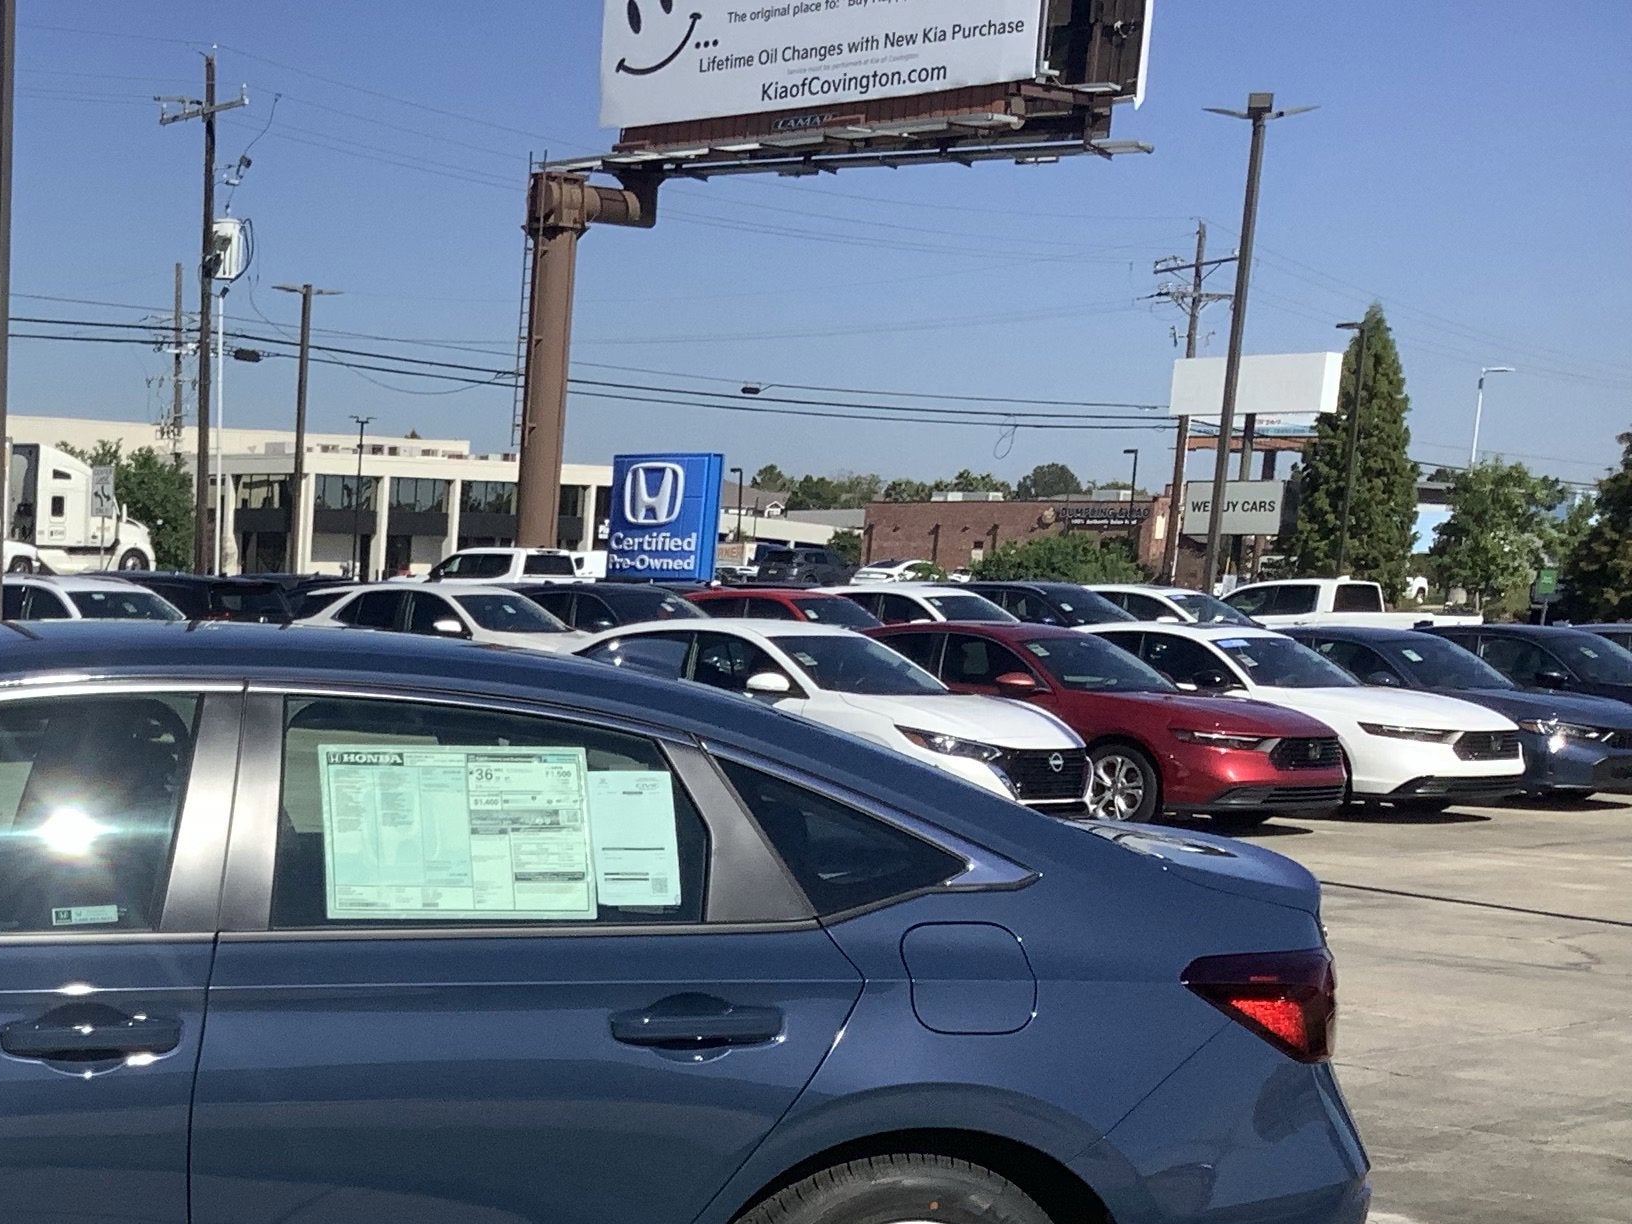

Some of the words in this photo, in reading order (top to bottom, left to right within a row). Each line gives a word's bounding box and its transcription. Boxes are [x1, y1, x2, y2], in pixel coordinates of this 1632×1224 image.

[728, 10, 747, 24] The
[750, 3, 791, 21] original
[792, 0, 822, 18] place
[699, 53, 755, 73] Lifetime
[758, 47, 777, 65] Oil
[781, 43, 844, 62] Changes
[848, 33, 880, 54] with
[884, 31, 918, 49] New
[922, 27, 947, 44] Kia
[952, 19, 1025, 41] Purchase
[761, 64, 947, 102] KiaofCovington.com
[1191, 501, 1210, 512] WE
[1241, 501, 1276, 512] CARS
[610, 532, 697, 552] Certified
[608, 554, 696, 571] Pre-Owned
[342, 753, 403, 764] HONDA
[475, 768, 494, 781] 36
